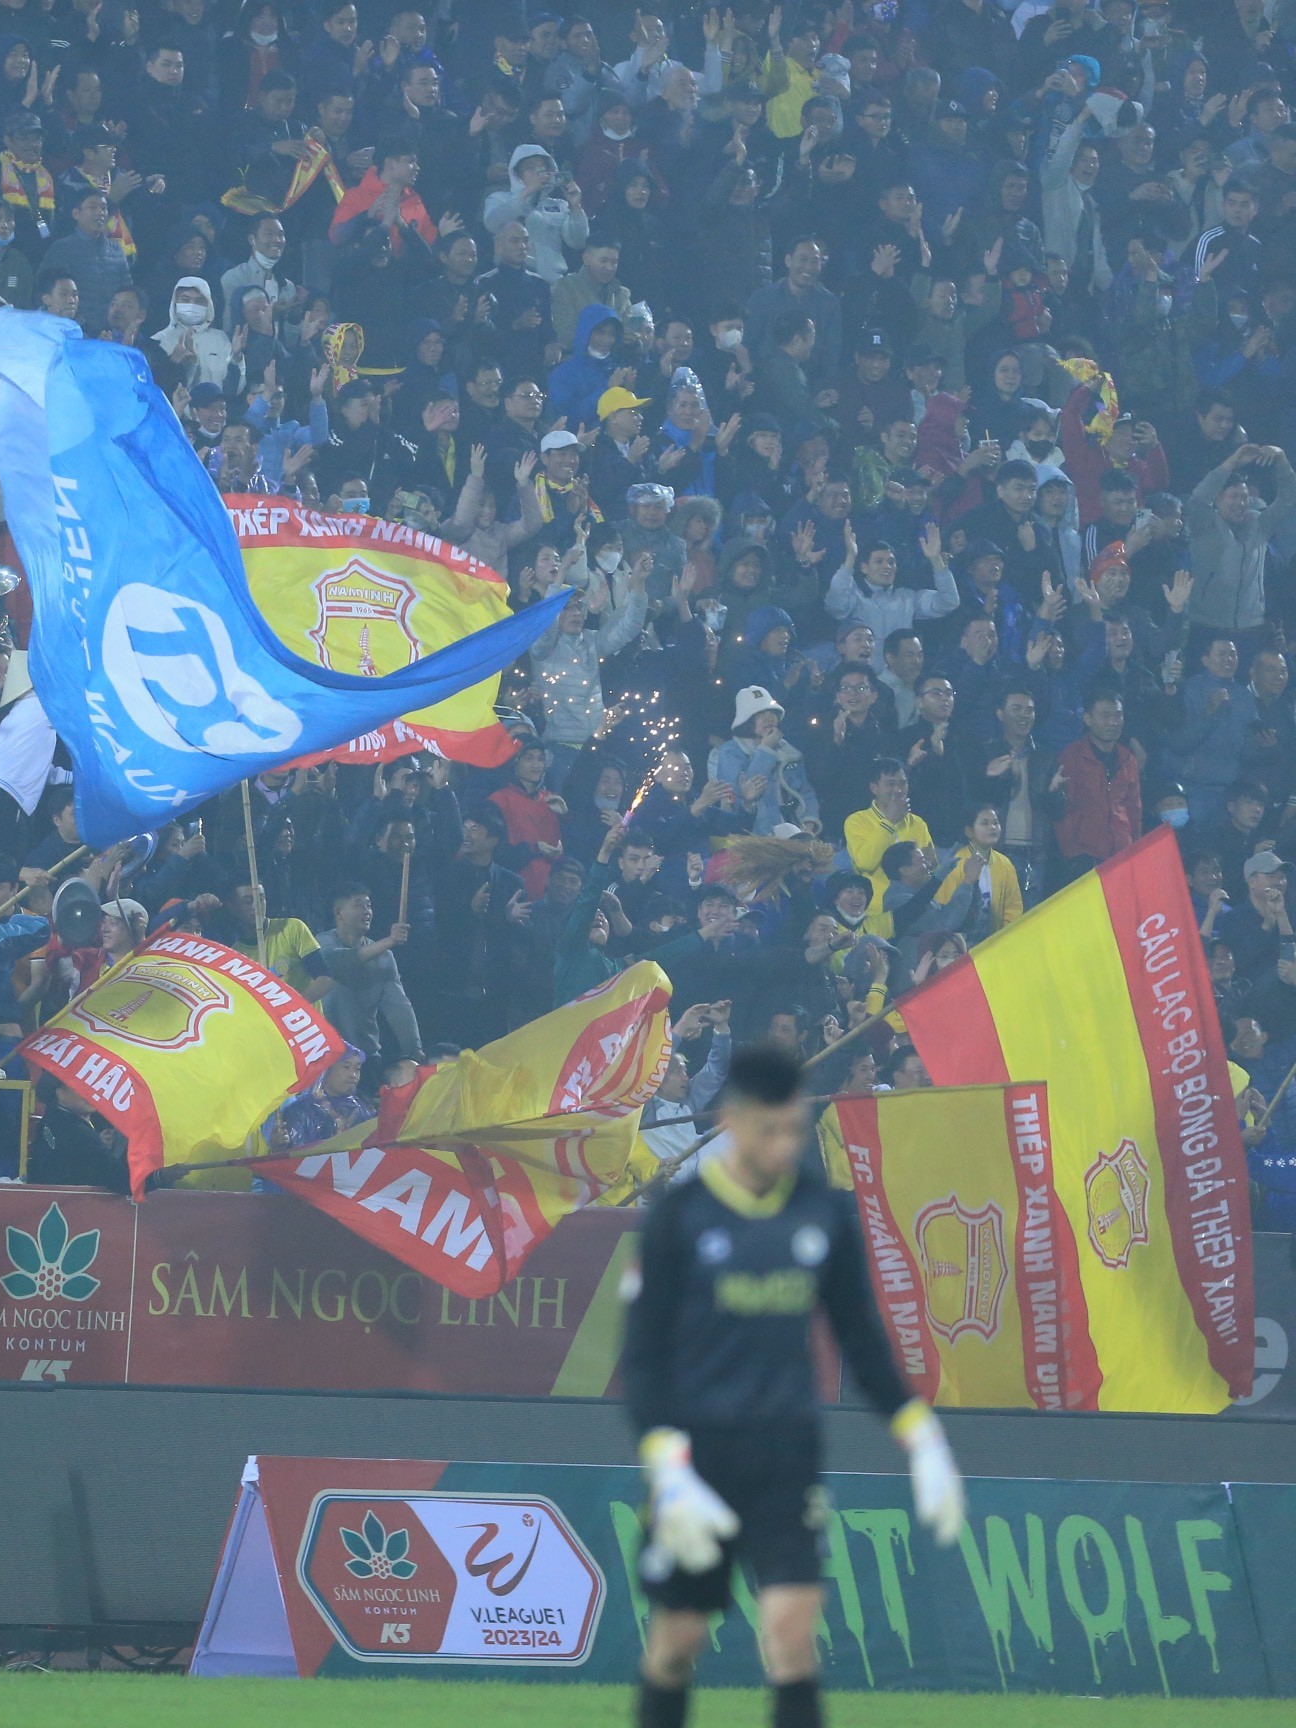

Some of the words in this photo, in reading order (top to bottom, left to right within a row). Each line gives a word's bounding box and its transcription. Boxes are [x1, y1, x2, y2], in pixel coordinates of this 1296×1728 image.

[293, 508, 367, 538] XANH
[370, 519, 443, 556] NAM
[328, 584, 395, 605] NAMDINH
[139, 968, 211, 998] NAMDINH
[146, 936, 225, 964] XANH
[221, 958, 293, 1008] NAM
[281, 1007, 332, 1067] ĐỊN
[1152, 970, 1192, 1031] LẠC
[27, 1033, 84, 1069] HẢI
[75, 1054, 136, 1113] HẬU
[1162, 1029, 1207, 1075] BỘ
[1012, 1093, 1048, 1176] THÉP
[1173, 1073, 1221, 1157] BÓNG
[1185, 1156, 1236, 1202] ĐÁ
[294, 1147, 494, 1273] NAM
[1023, 1184, 1053, 1273] XANH
[848, 1143, 874, 1184] FC
[888, 1300, 927, 1376] NAM
[148, 1249, 254, 1319] SÂM
[266, 1264, 424, 1334] NGỌC
[13, 1308, 72, 1333] NGỌC
[75, 1310, 126, 1332] LINH
[1028, 1282, 1057, 1353] NAM
[6, 1337, 86, 1353] KONTUM
[20, 1359, 73, 1382] K5
[1032, 1363, 1063, 1411] ĐỊN
[333, 1584, 361, 1601] SÂM
[364, 1587, 406, 1605] NGỌC
[406, 1588, 441, 1603] LINH
[364, 1606, 417, 1616] KONTUM
[959, 1513, 1232, 1690] WOLF
[380, 1622, 412, 1644] K5
